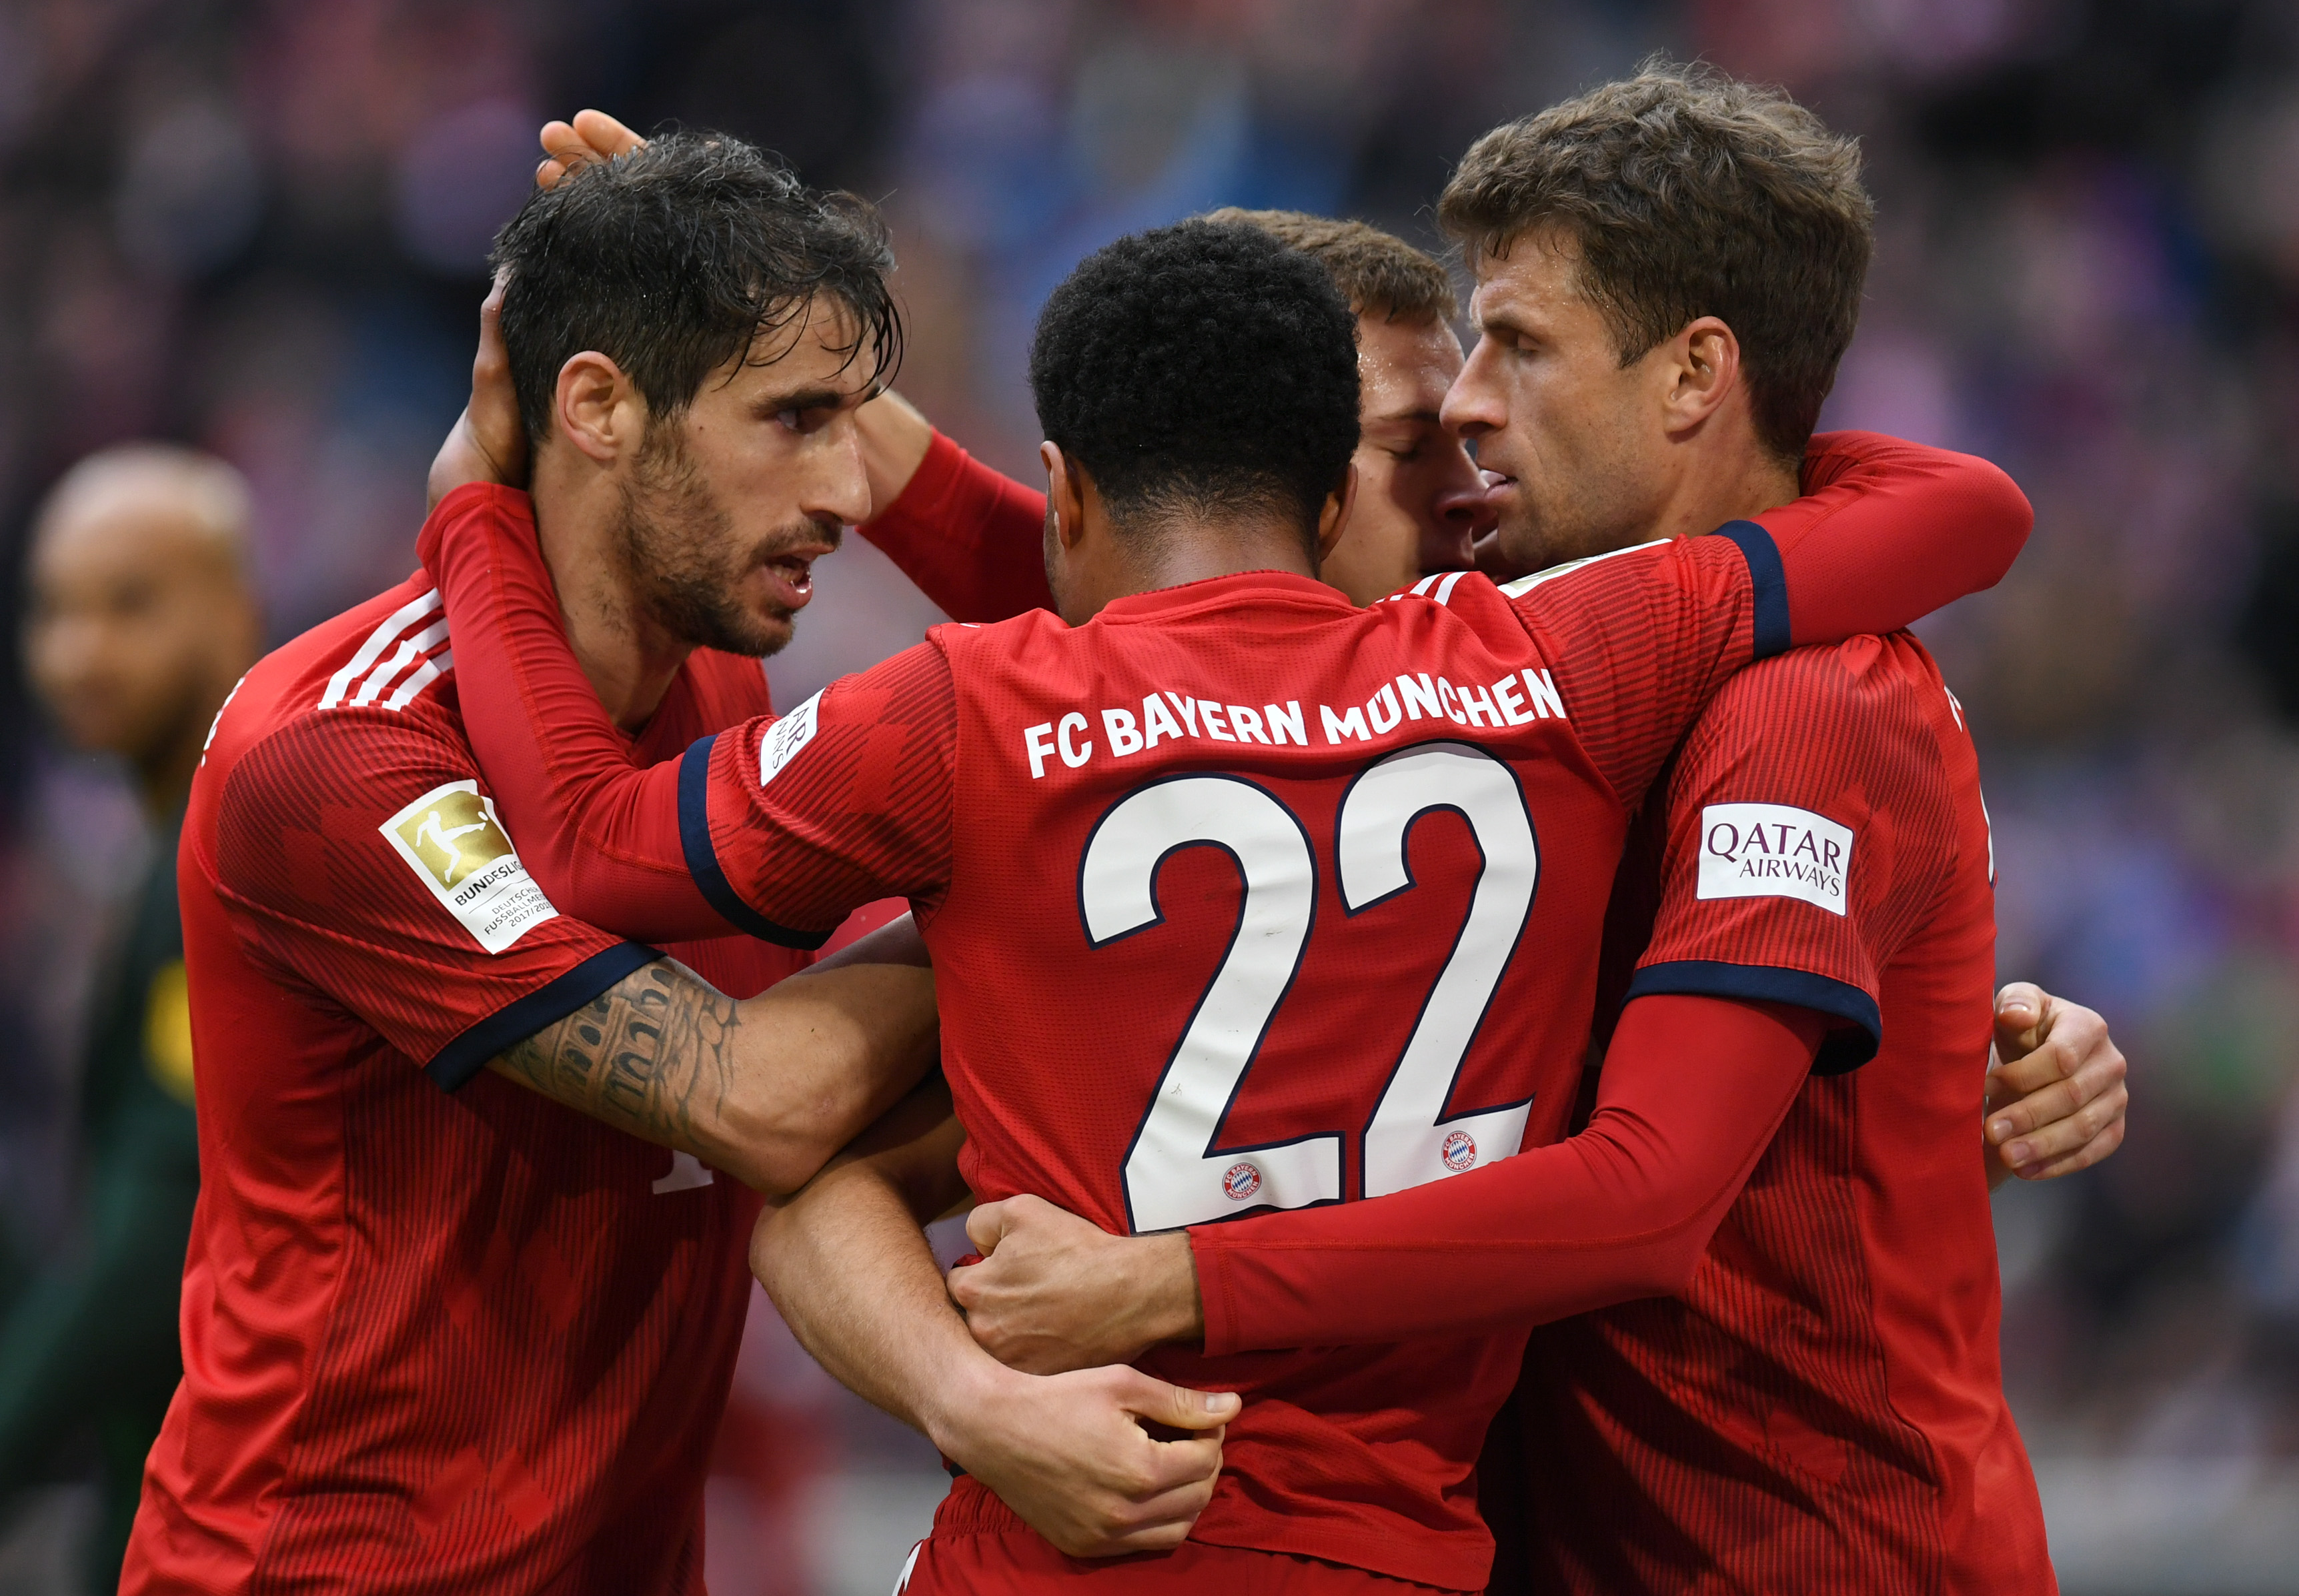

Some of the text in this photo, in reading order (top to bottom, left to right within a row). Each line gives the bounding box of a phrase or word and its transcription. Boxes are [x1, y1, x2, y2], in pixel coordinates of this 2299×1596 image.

[1024, 668, 1567, 780] FC BAYERN MÜNCHEN
[1707, 822, 1841, 876] QATAR
[1739, 858, 1841, 896] AIRWAYS
[1077, 738, 1541, 1235] 22
[1449, 1133, 1473, 1147] BAYERN
[1231, 1164, 1258, 1176] BAYERN
